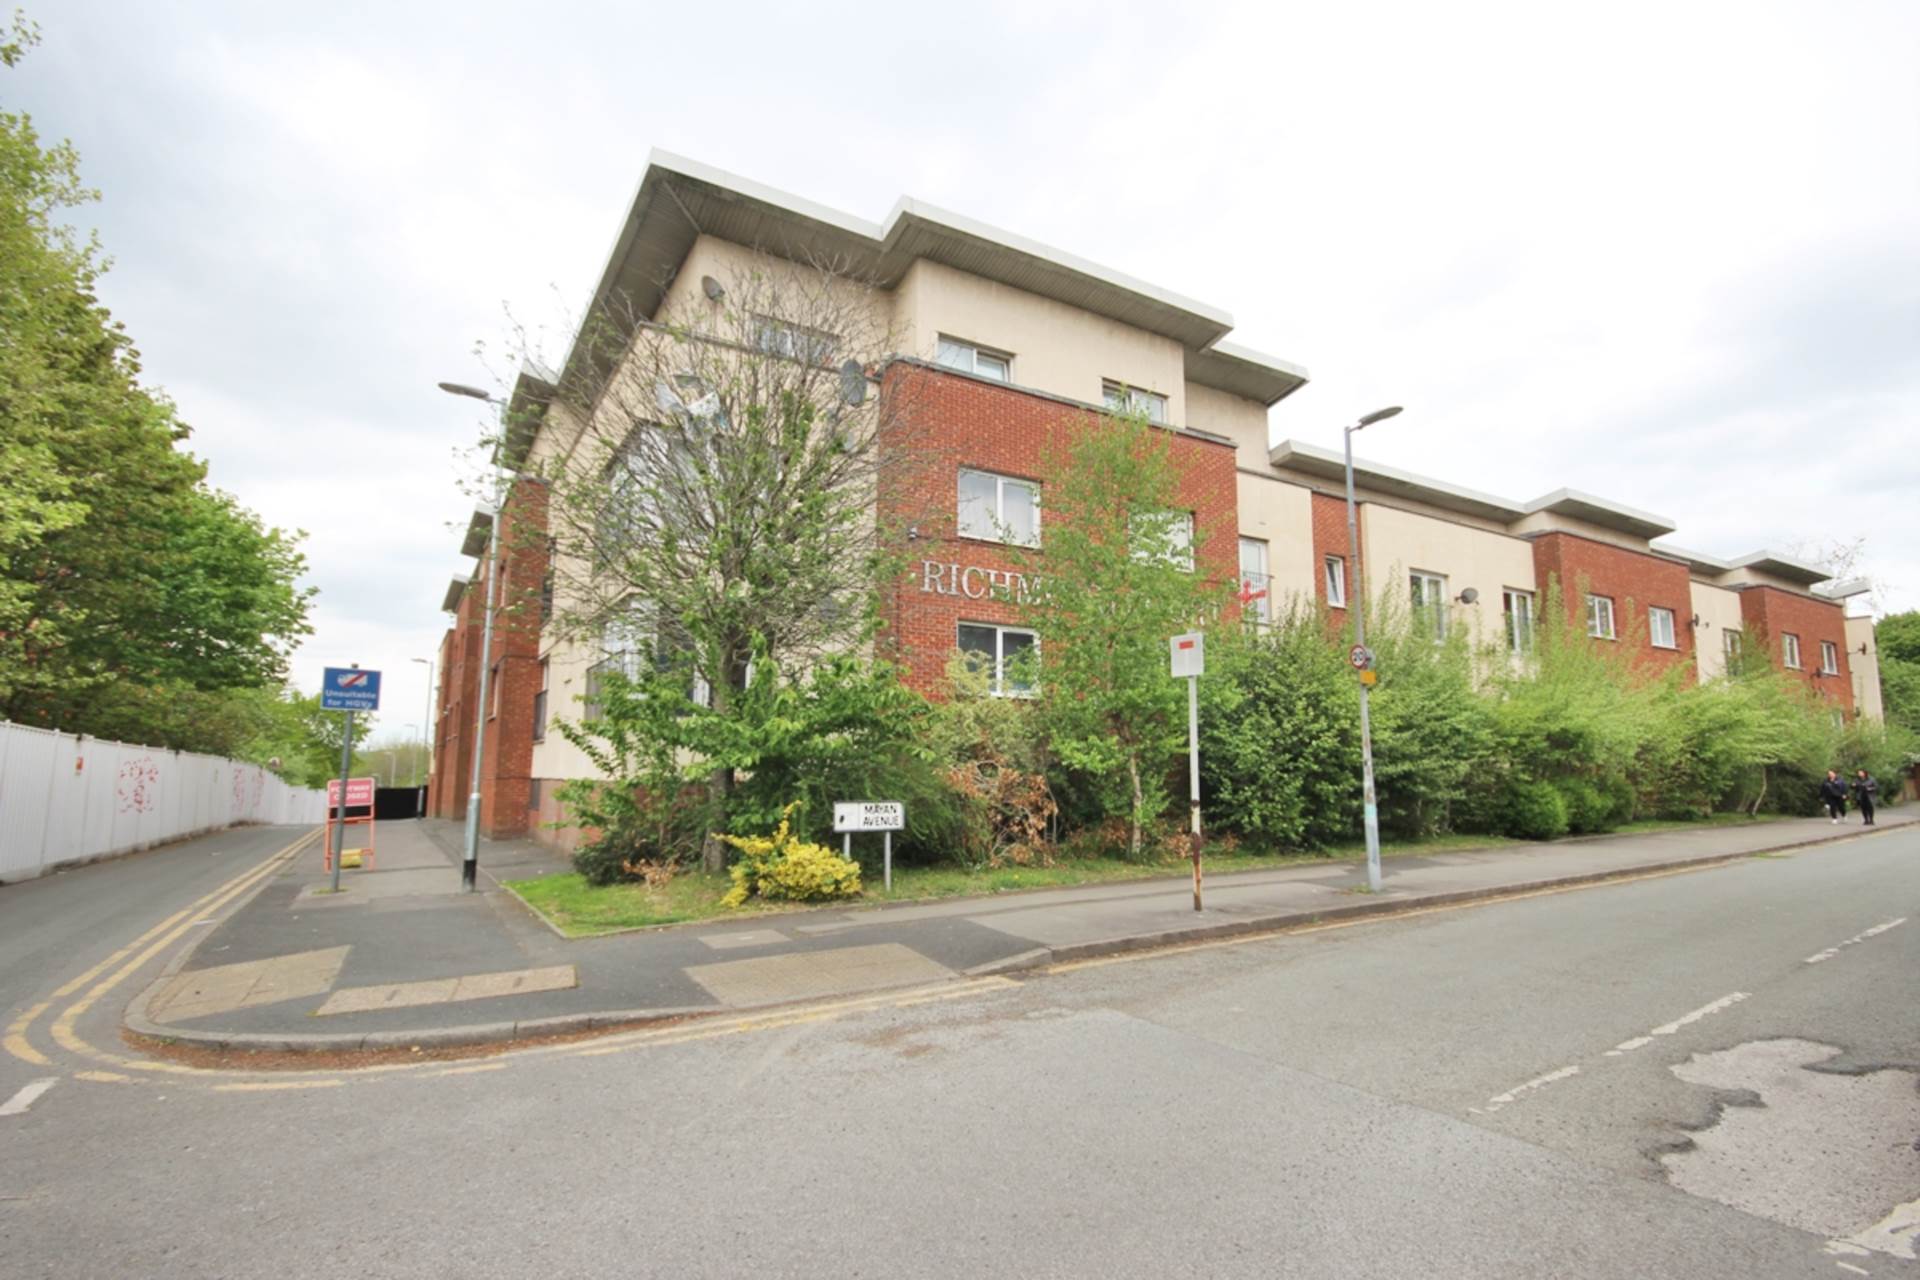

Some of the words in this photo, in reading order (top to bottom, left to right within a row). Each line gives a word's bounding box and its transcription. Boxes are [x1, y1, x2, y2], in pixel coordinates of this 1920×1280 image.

[920, 558, 1064, 608] RICHM
[325, 689, 376, 699] Unsuitable
[328, 699, 341, 708] for
[330, 785, 370, 793] FOTWAY
[334, 792, 369, 800] COSED
[864, 804, 898, 815] MAYAN
[863, 815, 900, 827] AVENUE
